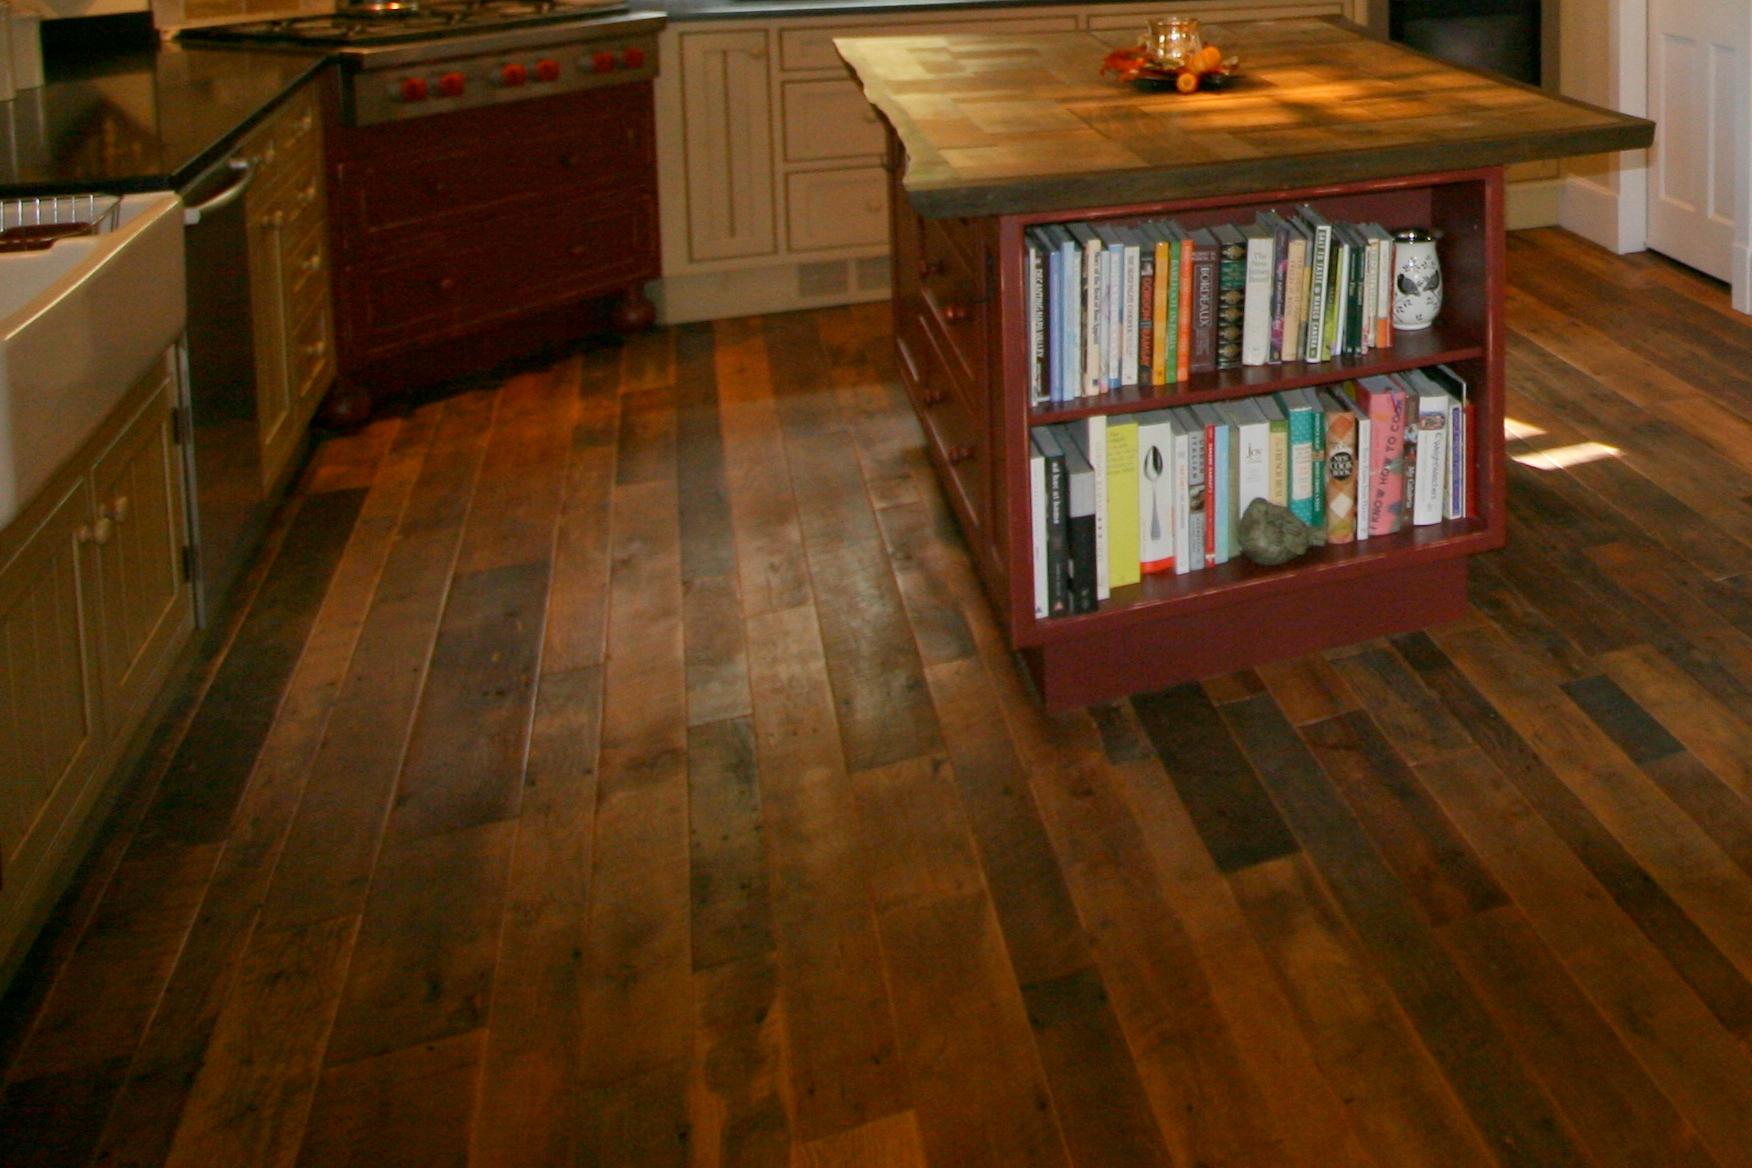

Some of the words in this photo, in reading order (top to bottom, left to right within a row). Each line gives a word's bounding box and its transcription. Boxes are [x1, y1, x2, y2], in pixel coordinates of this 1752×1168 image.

[1318, 231, 1327, 249] SALT
[1315, 264, 1324, 284] TASTE
[1141, 277, 1151, 321] GORDON
[1199, 267, 1210, 328] BORDEAUX
[1313, 296, 1322, 319] MARCO
[1140, 328, 1150, 368] RAMSAY
[1247, 442, 1264, 459] Joy
[1385, 435, 1398, 454] TO
[1331, 462, 1352, 470] COOK
[1379, 458, 1393, 485] HOW
[1406, 465, 1416, 477] My
[1051, 475, 1061, 488] hoc
[1406, 479, 1416, 509] Calabria
[1052, 501, 1061, 524] home
[1372, 489, 1387, 524] KNOW
